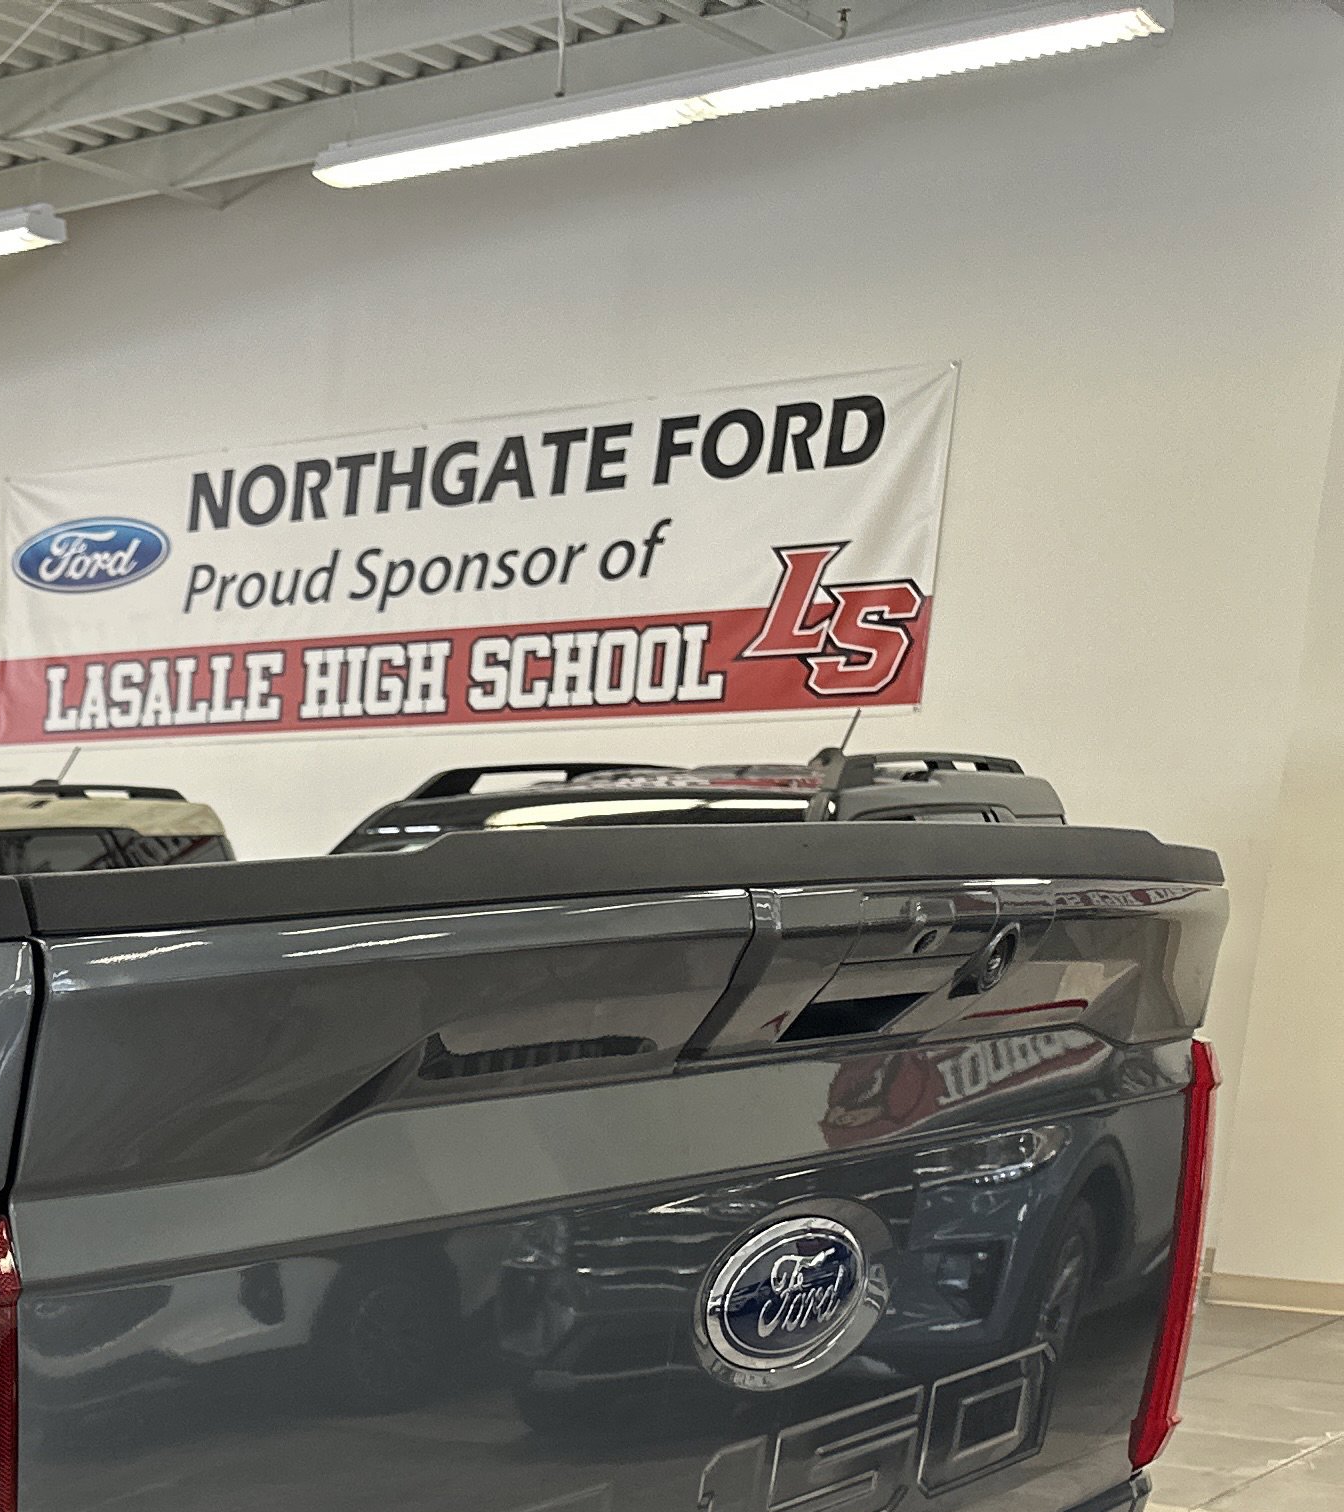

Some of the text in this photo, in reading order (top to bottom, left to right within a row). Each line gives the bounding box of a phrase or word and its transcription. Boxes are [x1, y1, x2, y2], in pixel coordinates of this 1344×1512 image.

[187, 395, 886, 532] NORTHGATE FORD
[183, 517, 672, 614] Proud Sponsor of
[736, 540, 926, 698] LS
[43, 622, 726, 734] LASALLE HIGH SCHOOL
